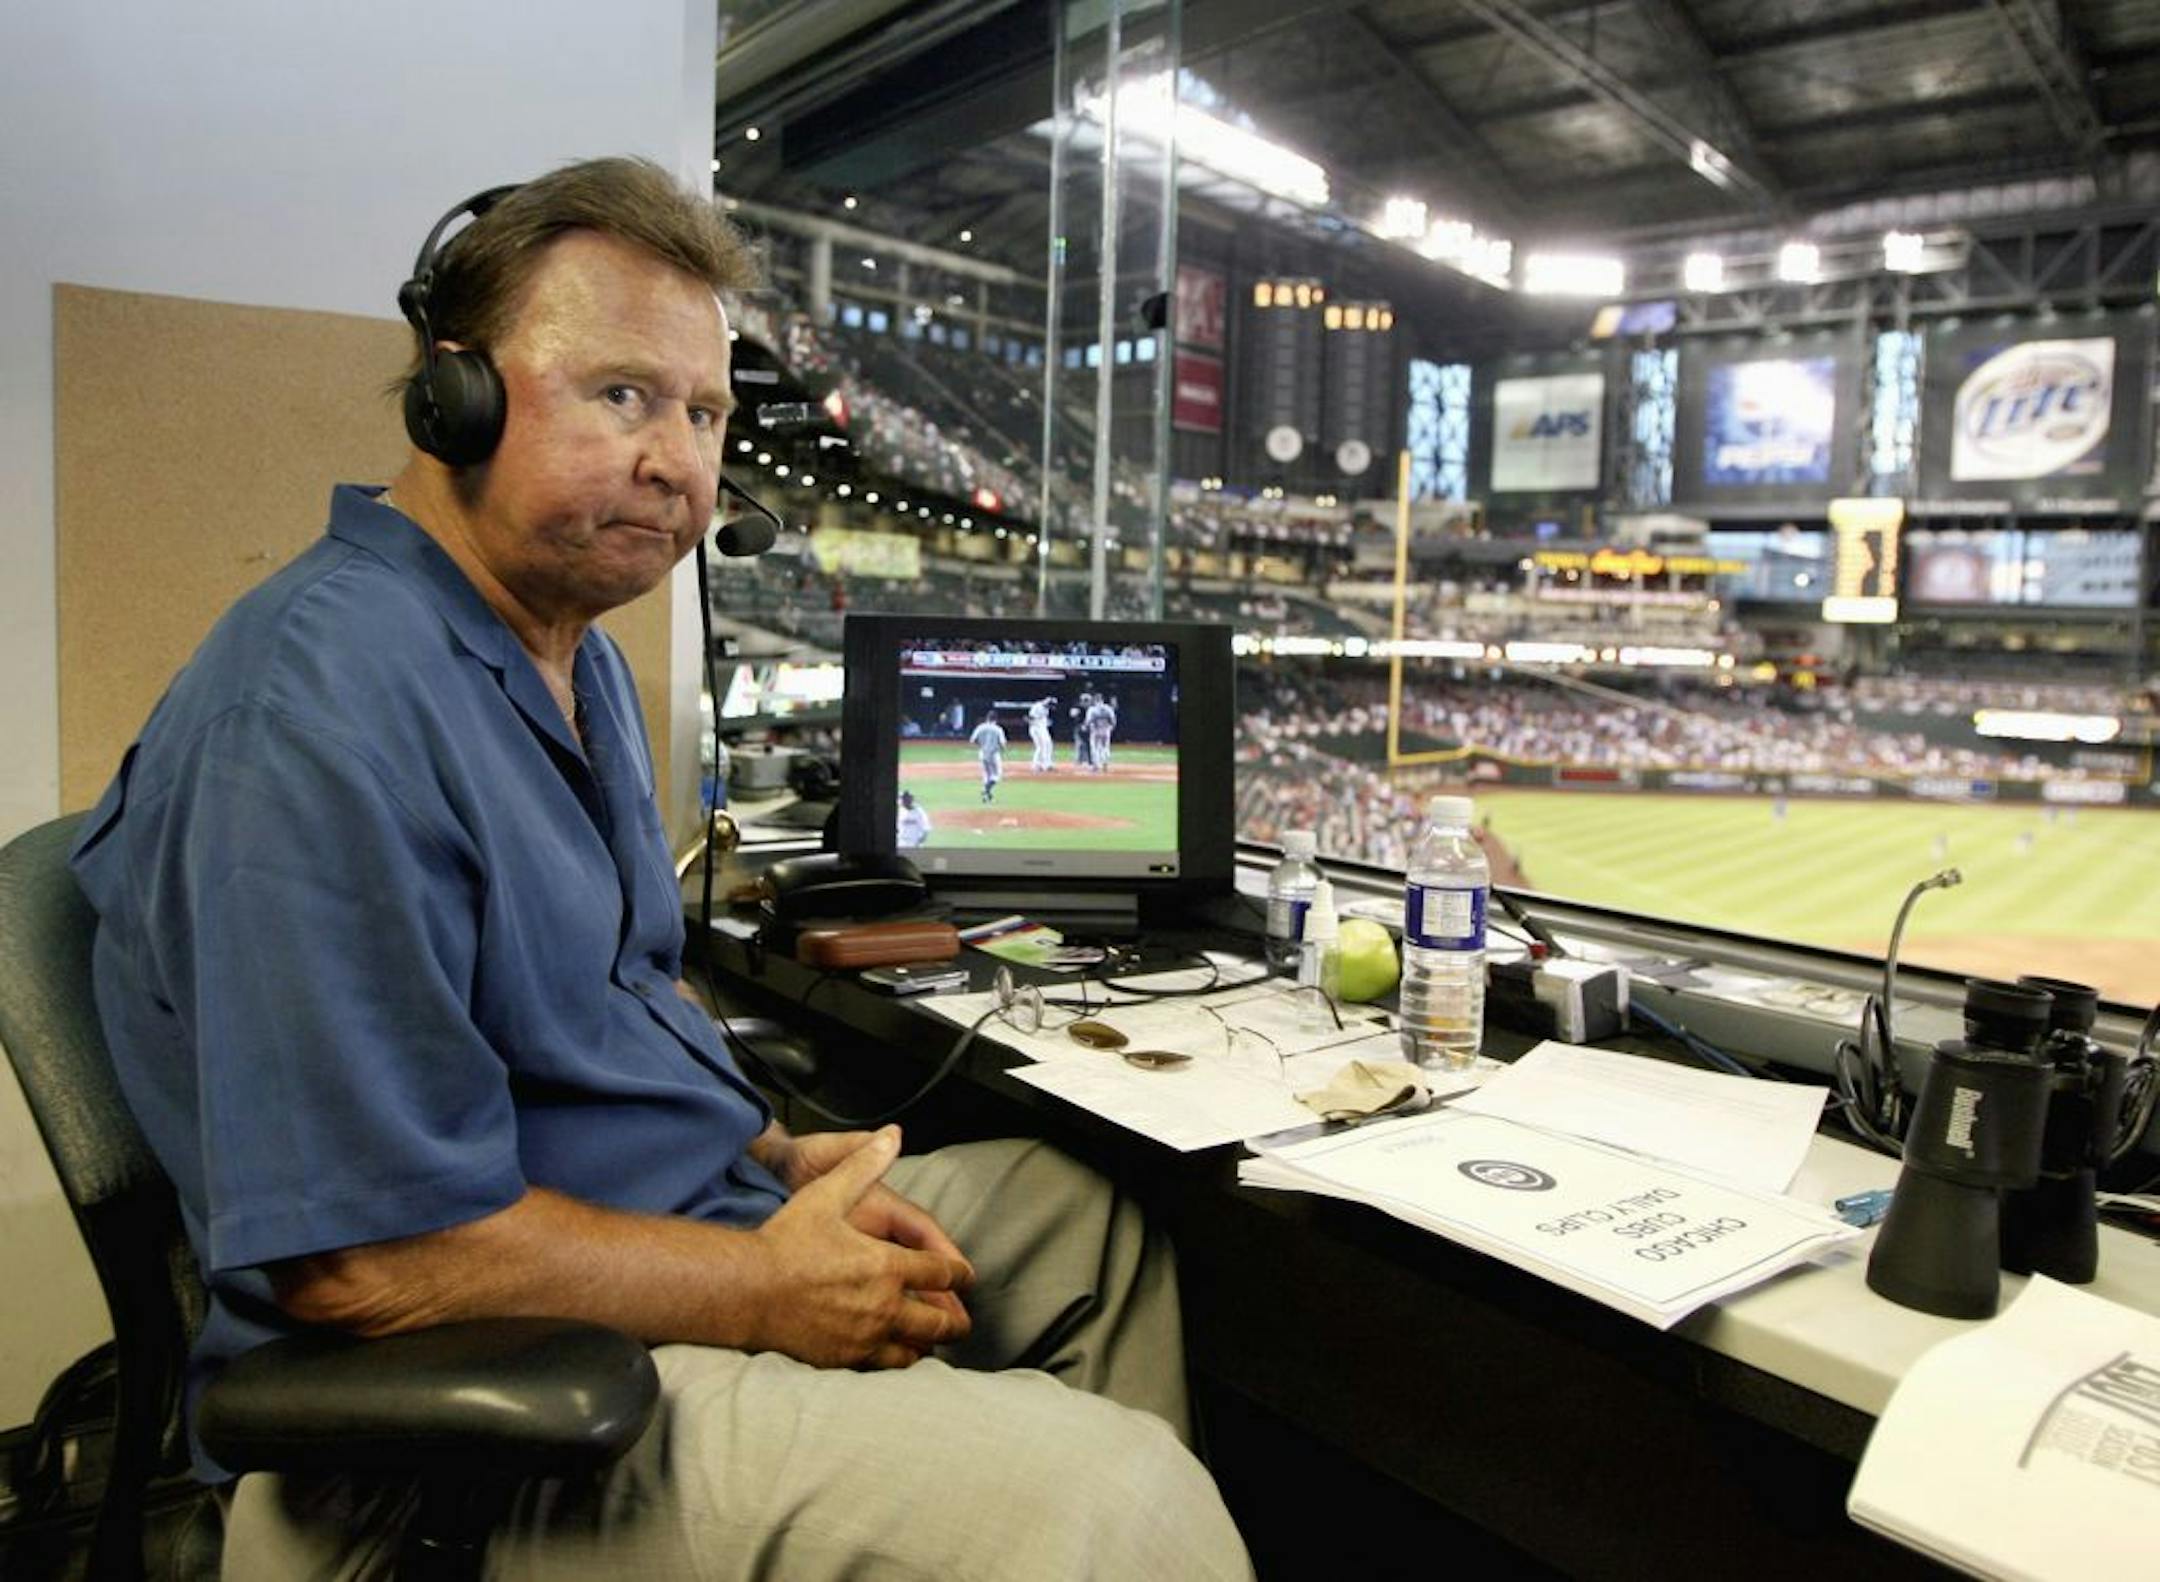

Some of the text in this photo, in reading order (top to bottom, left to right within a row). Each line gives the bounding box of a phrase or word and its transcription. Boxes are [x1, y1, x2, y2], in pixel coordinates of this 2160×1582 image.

[1534, 1187, 1682, 1237] DAILY CLIPS
[1612, 1211, 1687, 1239] CUBS
[1634, 1216, 1748, 1262] CHICAGO
